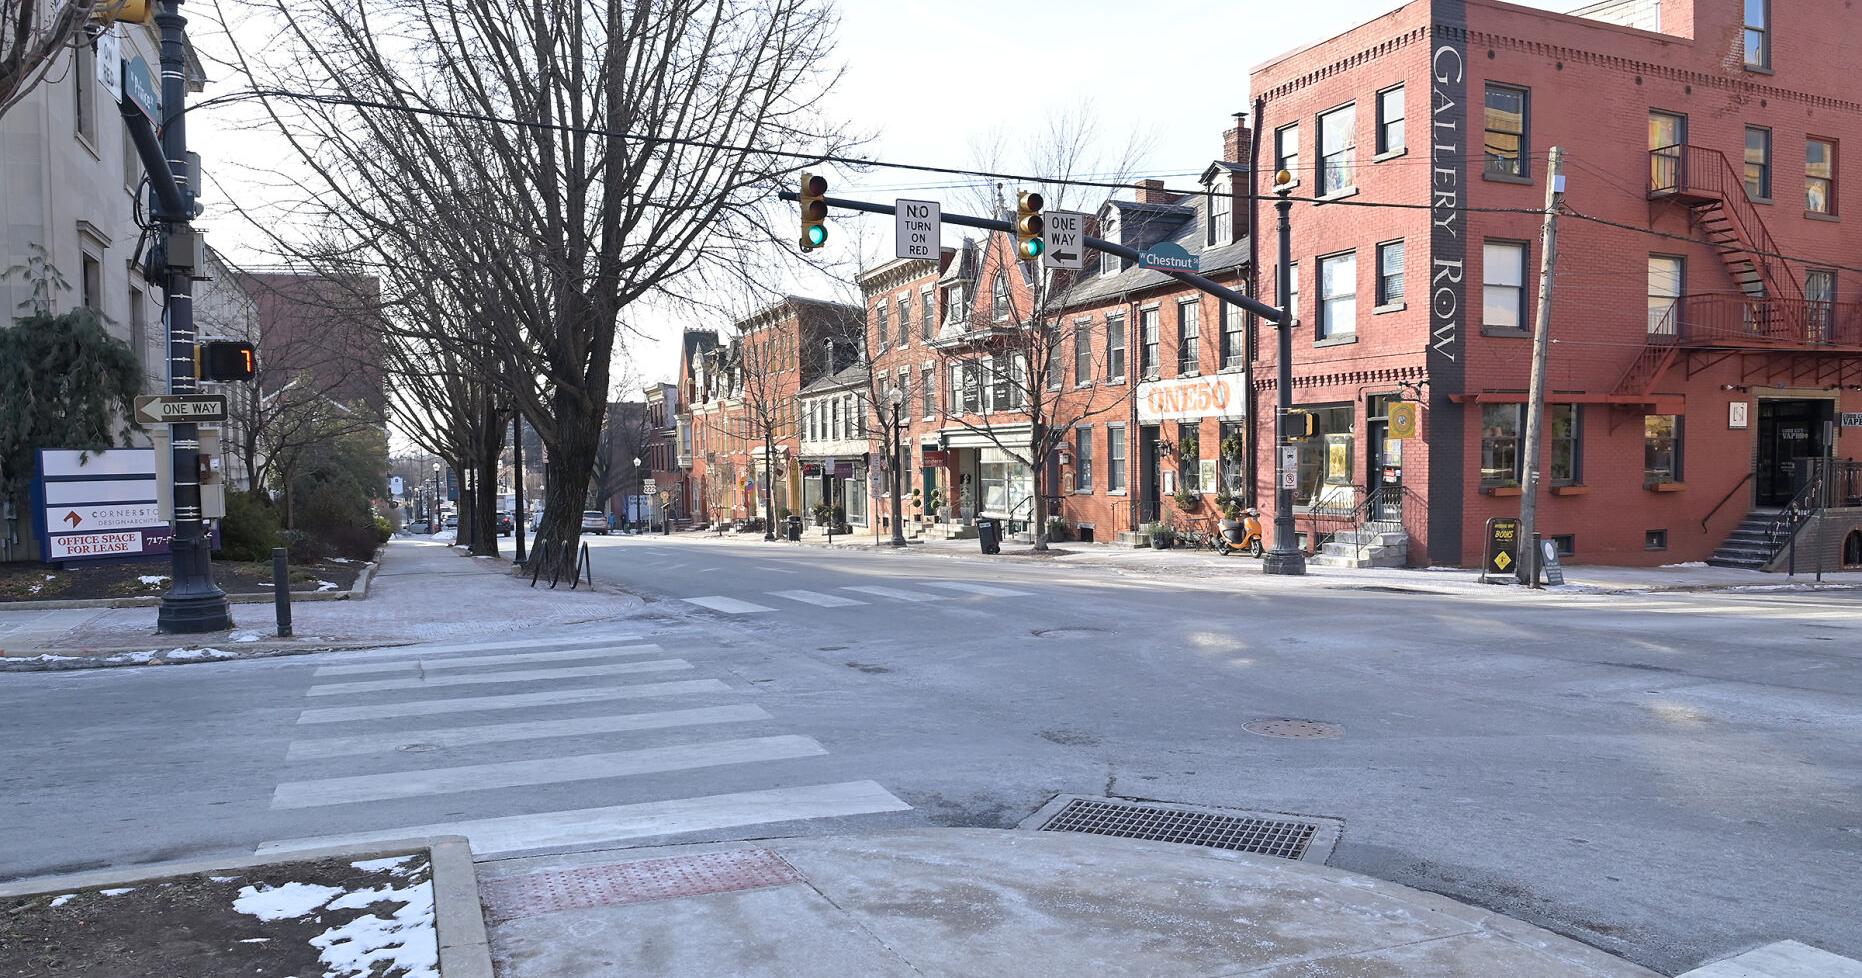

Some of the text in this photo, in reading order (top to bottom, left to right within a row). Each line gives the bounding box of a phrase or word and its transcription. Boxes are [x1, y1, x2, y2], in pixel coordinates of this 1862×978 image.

[1433, 45, 1463, 363] GALLERY ROW
[906, 204, 929, 219] NO
[905, 220, 931, 232] TURN
[1051, 216, 1076, 231] ONE
[911, 233, 926, 243] ON
[1051, 233, 1076, 246] WAY
[909, 245, 929, 256] RED
[1146, 253, 1192, 268] Chestnut
[240, 349, 252, 373] 7
[163, 402, 218, 415] ONE WAY
[57, 533, 136, 546] OFFICE SPACE
[67, 542, 129, 554] FOR LEASE
